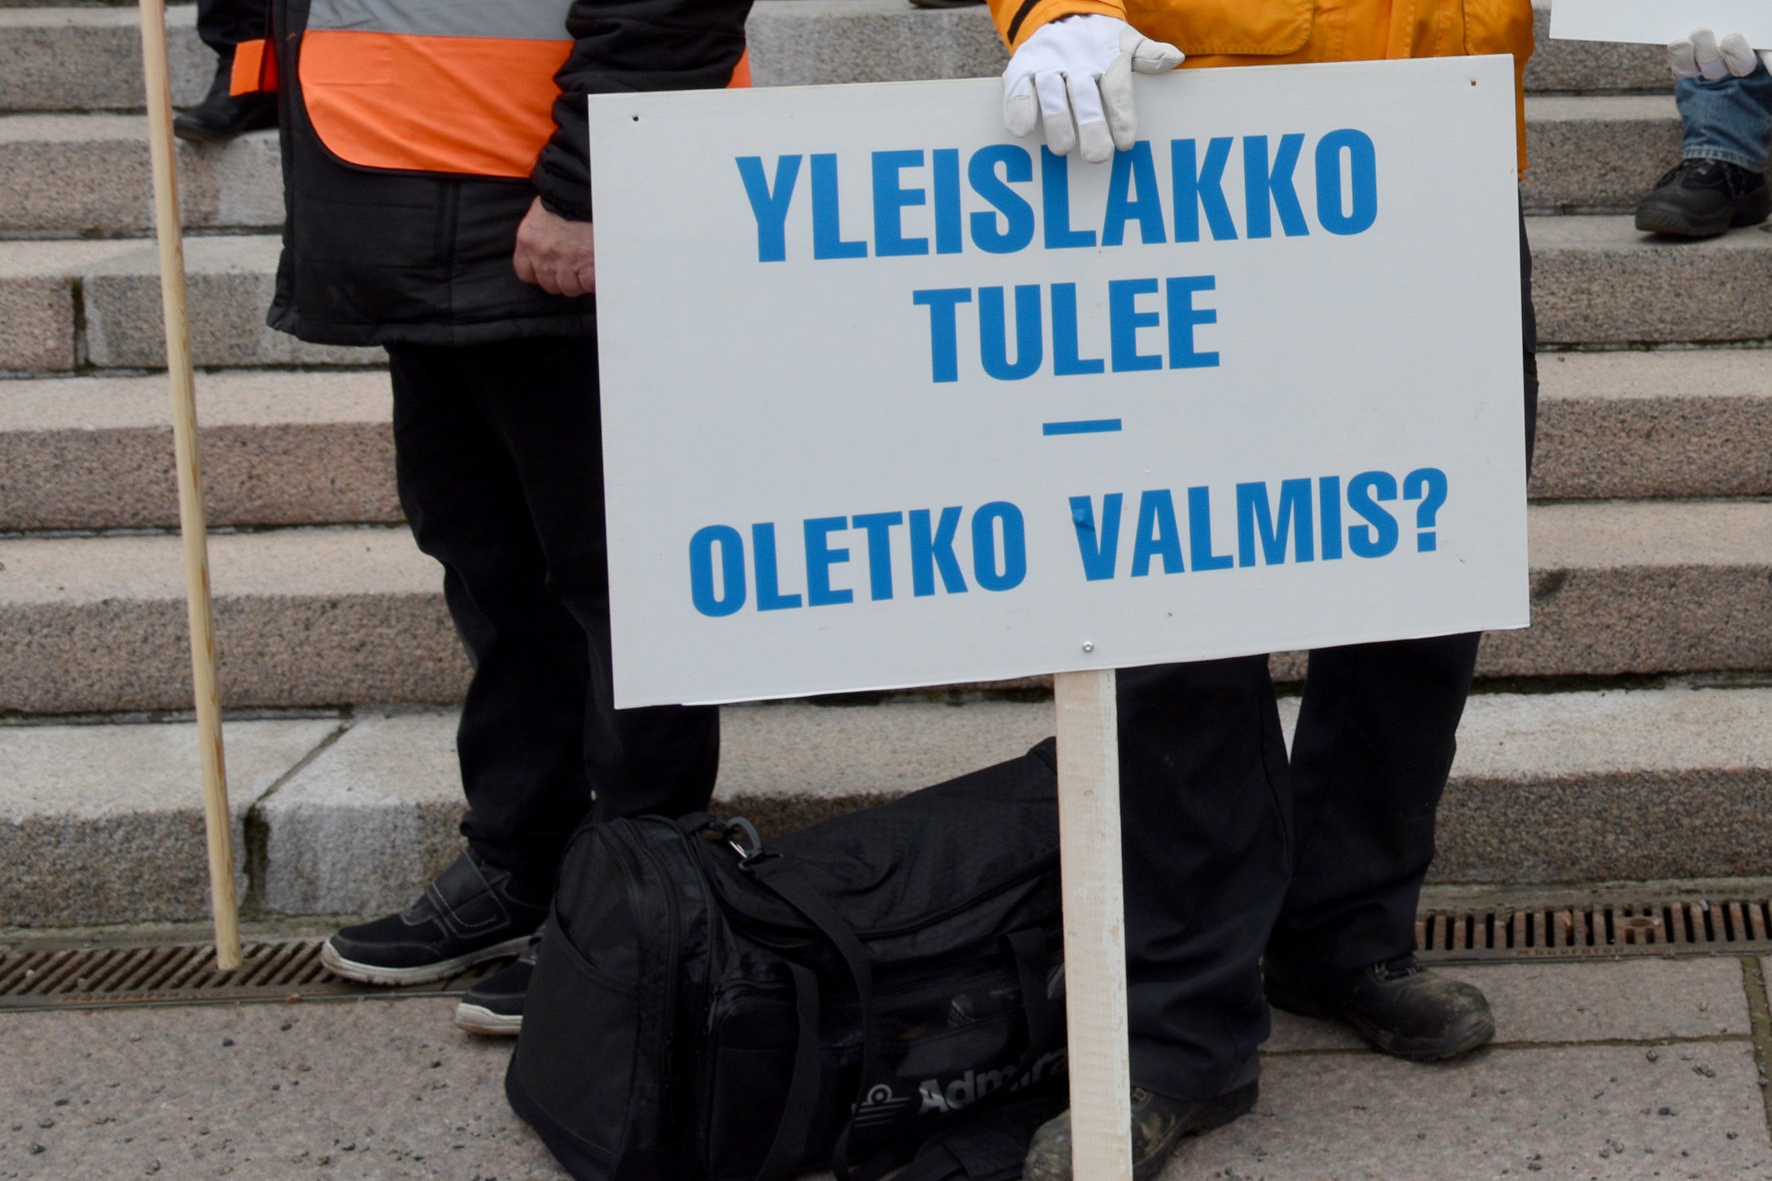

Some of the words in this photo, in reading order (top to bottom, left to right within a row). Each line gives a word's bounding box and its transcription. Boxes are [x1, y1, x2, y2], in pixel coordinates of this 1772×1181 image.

[735, 128, 1378, 264] YLEISLAKKO
[912, 274, 1221, 384] TULEE
[687, 500, 1028, 619] OLETKO
[1068, 466, 1450, 584] VALMIS?
